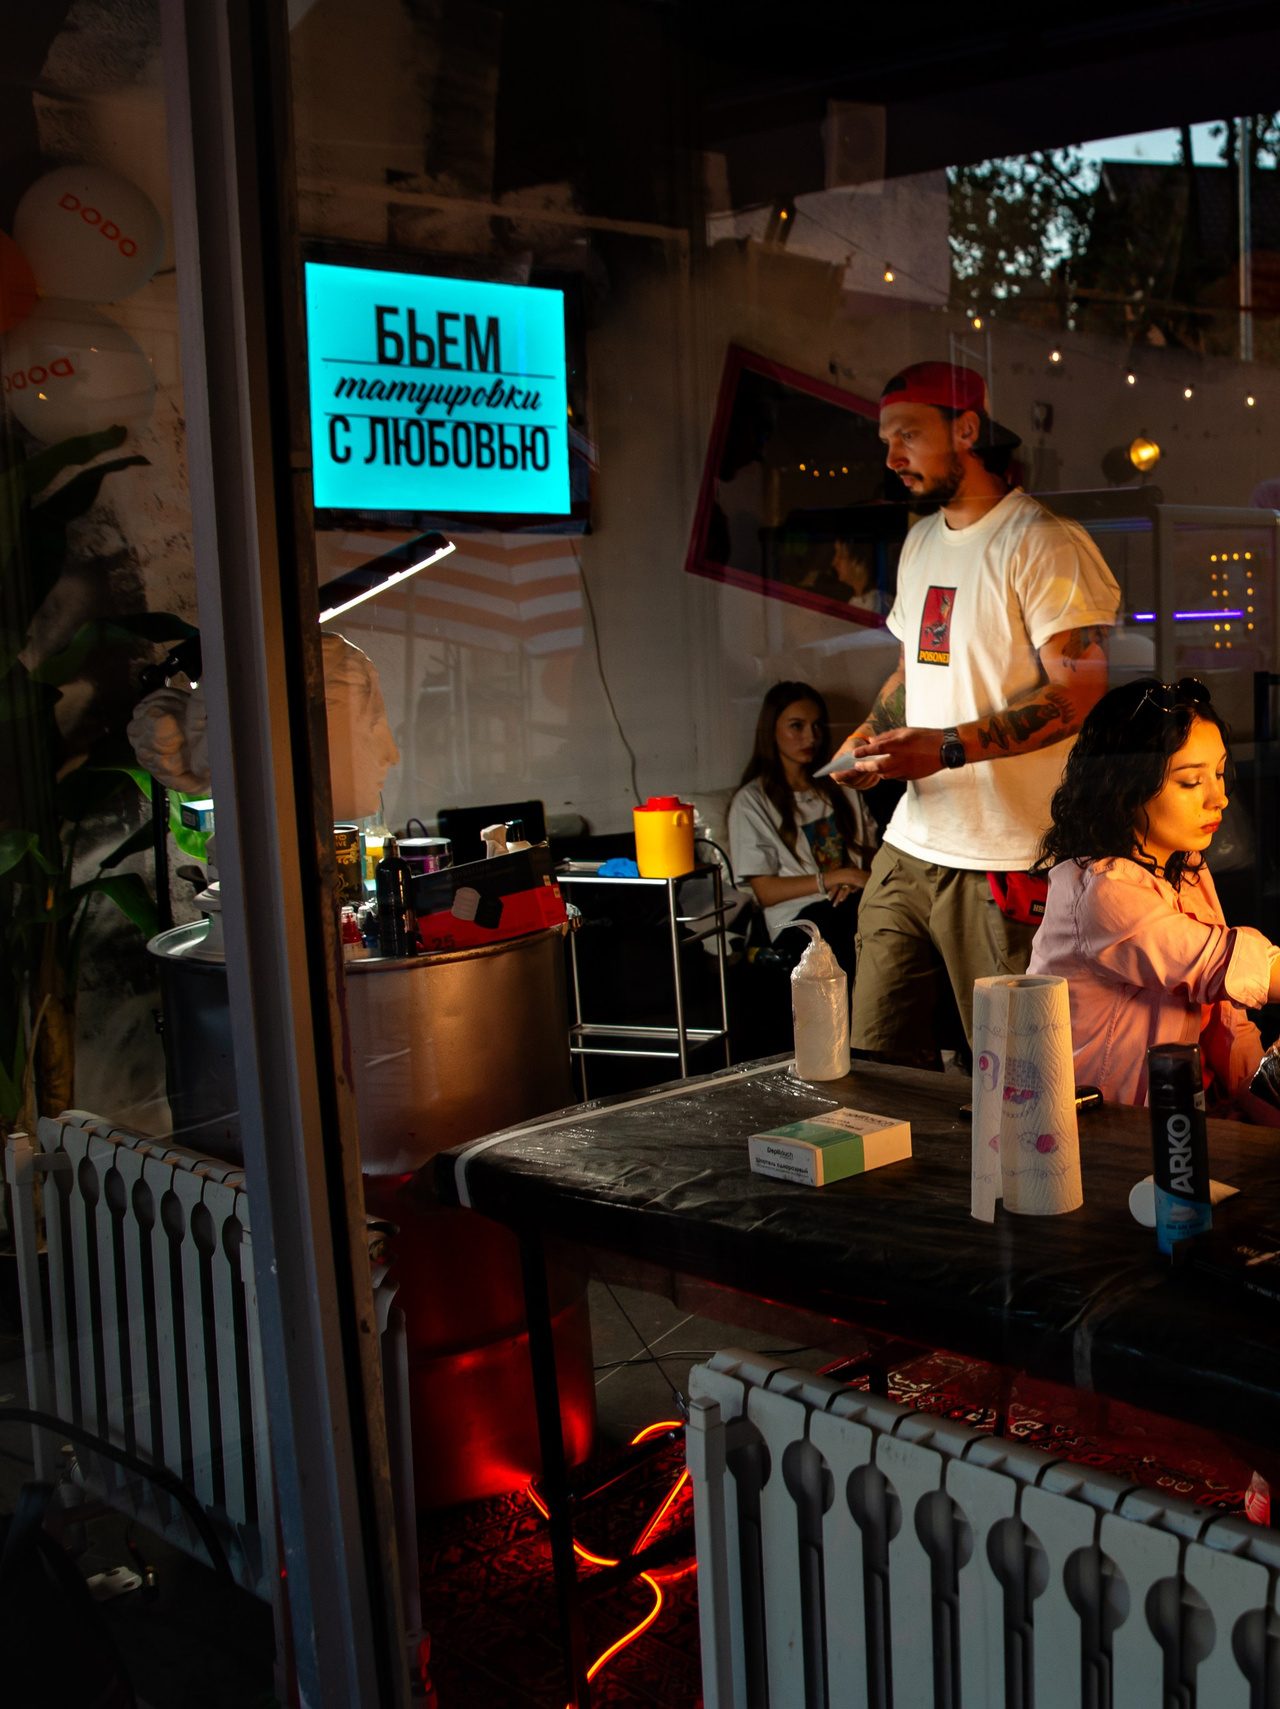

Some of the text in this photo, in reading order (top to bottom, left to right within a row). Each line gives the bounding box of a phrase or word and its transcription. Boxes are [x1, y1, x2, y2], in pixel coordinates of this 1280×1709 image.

[59, 192, 137, 258] DODO
[374, 304, 500, 373] БЬЕМ
[333, 376, 544, 416] татуировки
[328, 415, 550, 472] С ЛЮБОВЬЮ
[1166, 1113, 1195, 1196] ARKO
